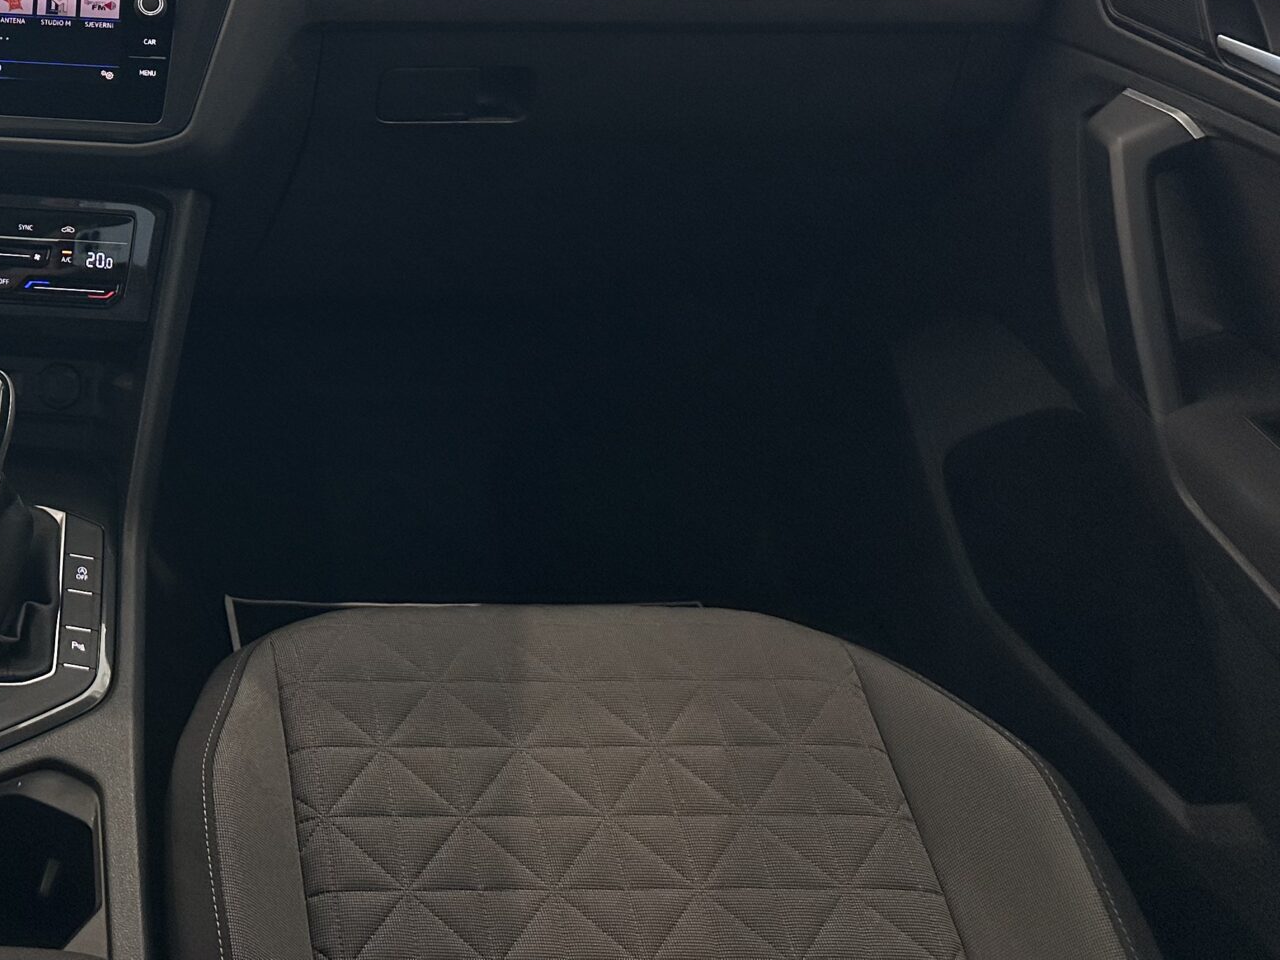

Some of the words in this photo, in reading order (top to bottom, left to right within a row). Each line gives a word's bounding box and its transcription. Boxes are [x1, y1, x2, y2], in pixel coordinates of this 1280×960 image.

[0, 17, 26, 25] ANTENA
[84, 21, 114, 29] SJEVERNI
[143, 38, 157, 46] CAR
[139, 69, 157, 77] MENU
[18, 223, 34, 231] SYNC
[60, 256, 72, 264] A/C
[85, 251, 114, 270] 20.0
[76, 573, 89, 581] OFF
